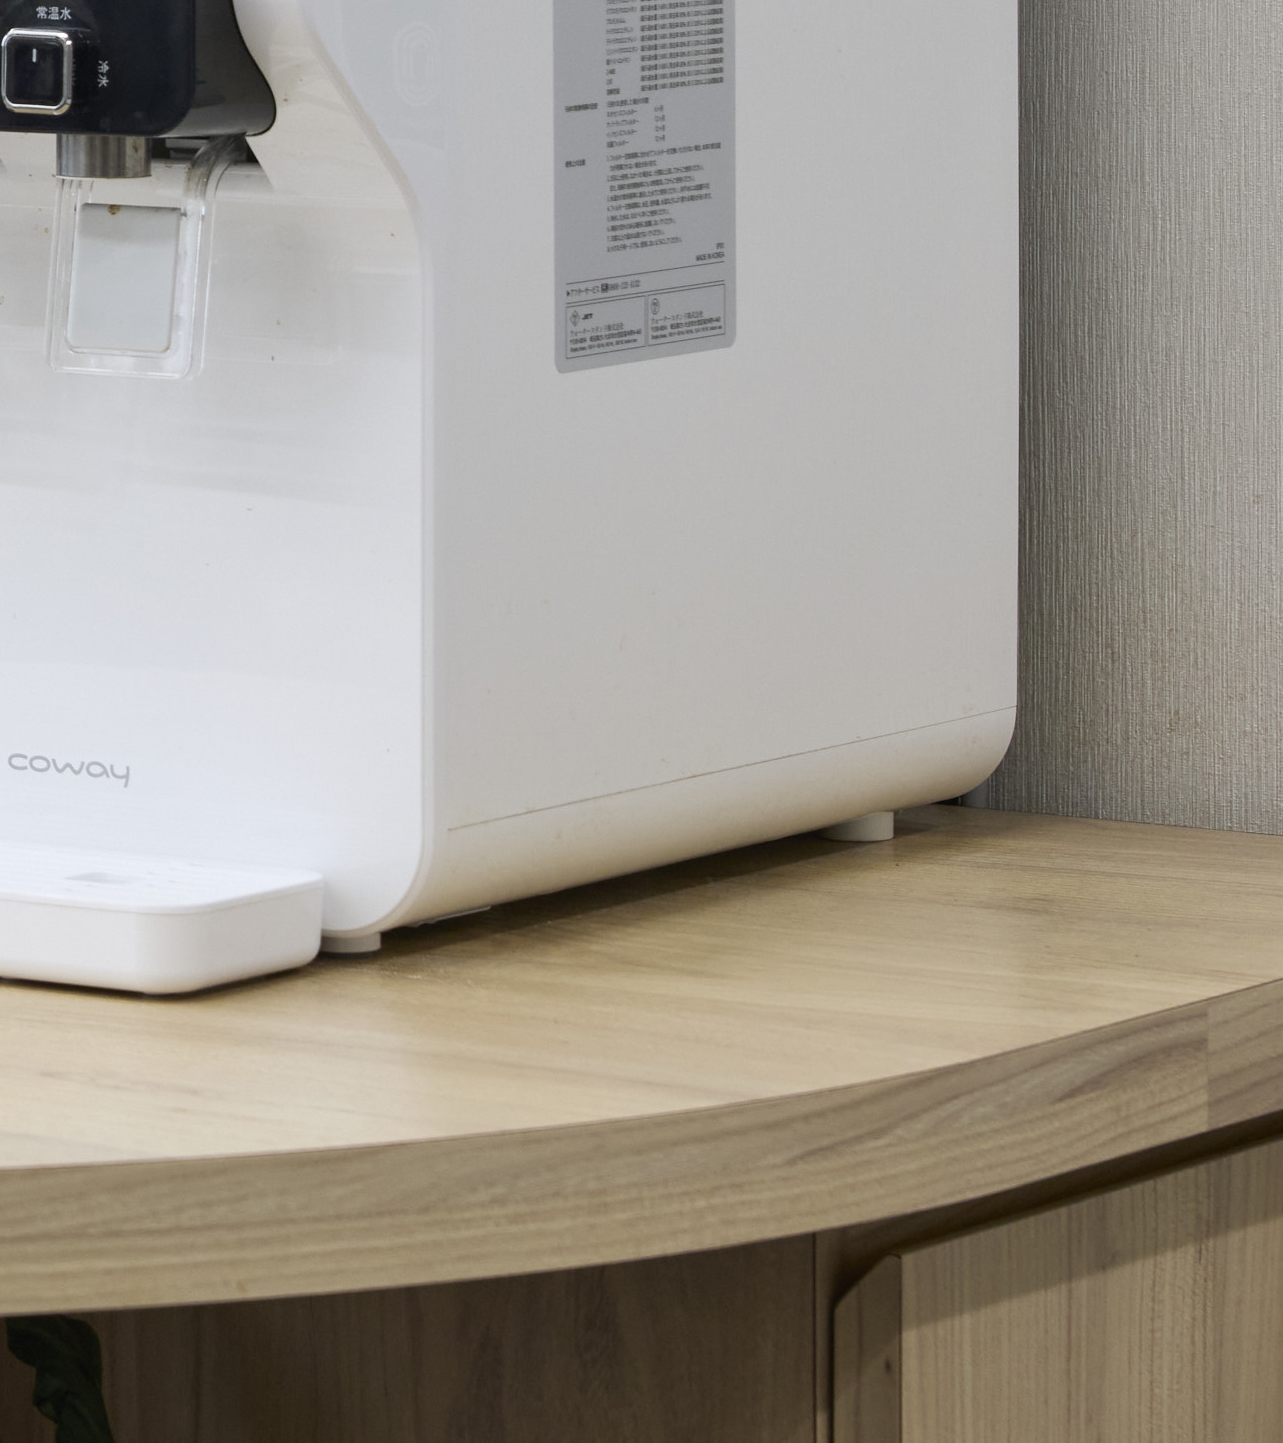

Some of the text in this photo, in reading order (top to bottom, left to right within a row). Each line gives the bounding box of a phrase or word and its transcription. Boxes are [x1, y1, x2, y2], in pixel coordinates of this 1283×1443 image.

[36, 6, 72, 20] 常温水
[97, 60, 110, 87] 冷水
[7, 752, 130, 788] coway
